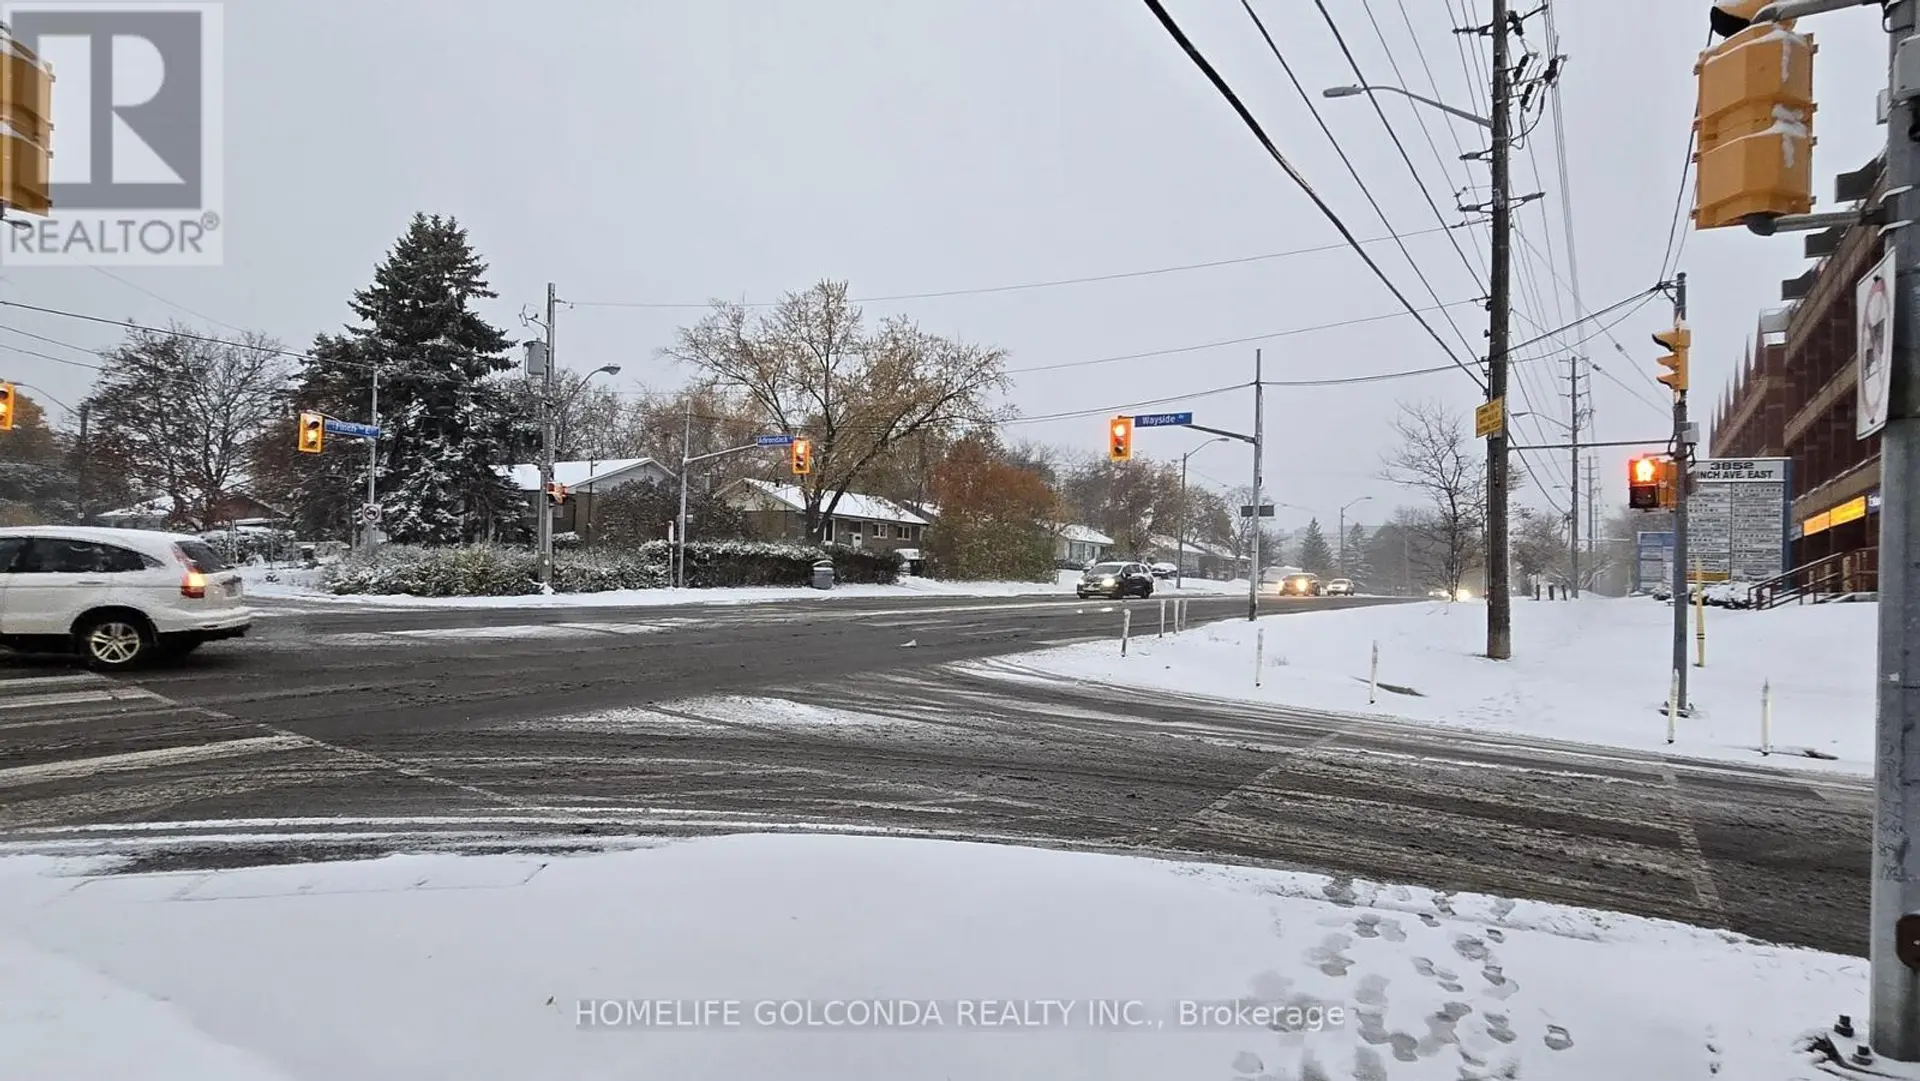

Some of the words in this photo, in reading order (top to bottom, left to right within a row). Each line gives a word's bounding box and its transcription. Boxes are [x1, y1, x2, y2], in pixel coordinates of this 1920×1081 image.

[1142, 415, 1176, 426] Wayside
[1710, 462, 1755, 471] 3852
[1747, 470, 1774, 479] EAST
